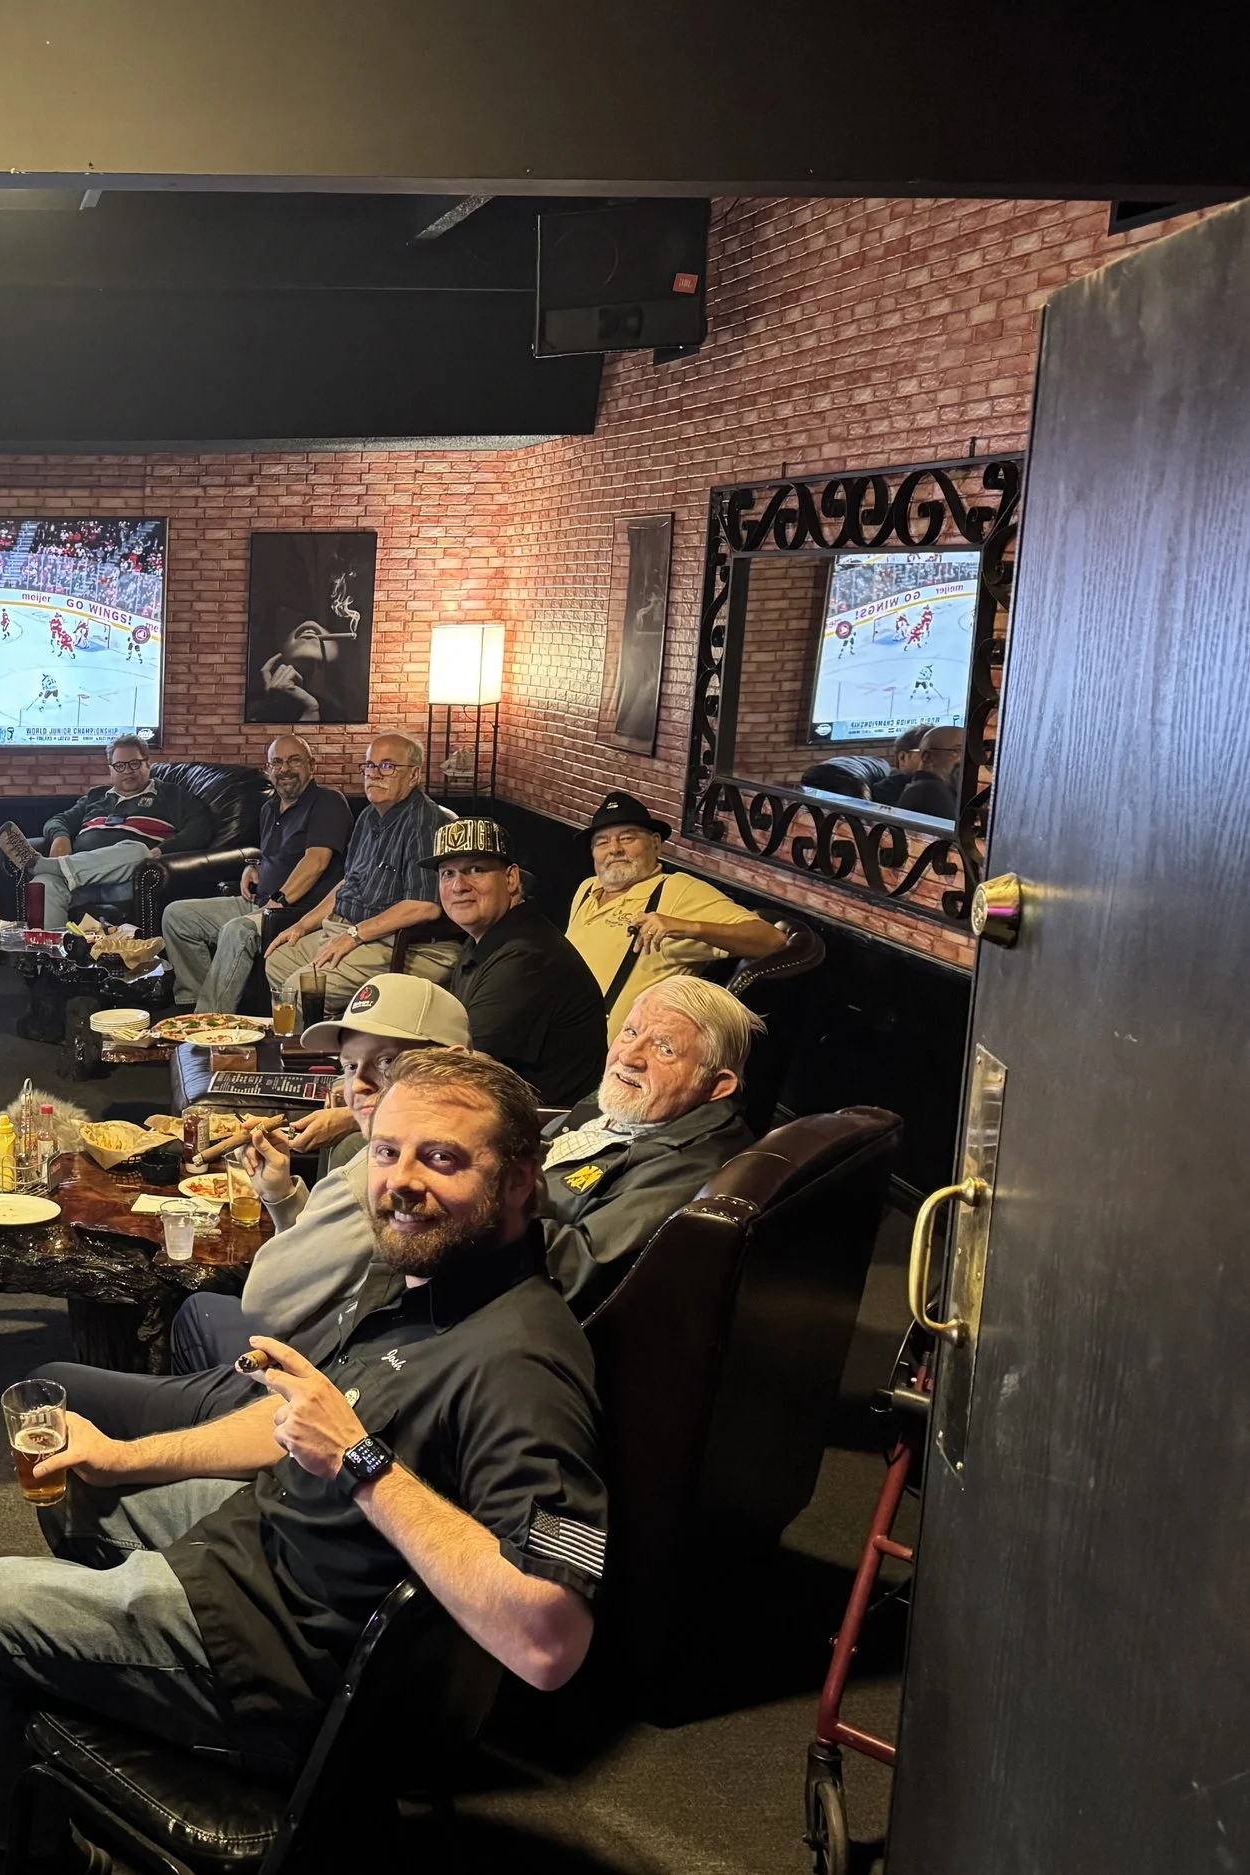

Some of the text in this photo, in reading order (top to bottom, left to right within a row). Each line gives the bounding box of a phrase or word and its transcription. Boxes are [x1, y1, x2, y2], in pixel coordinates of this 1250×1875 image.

[22, 592, 51, 604] meijer
[66, 598, 132, 626] GO WINGS!
[380, 1349, 406, 1371] Josh
